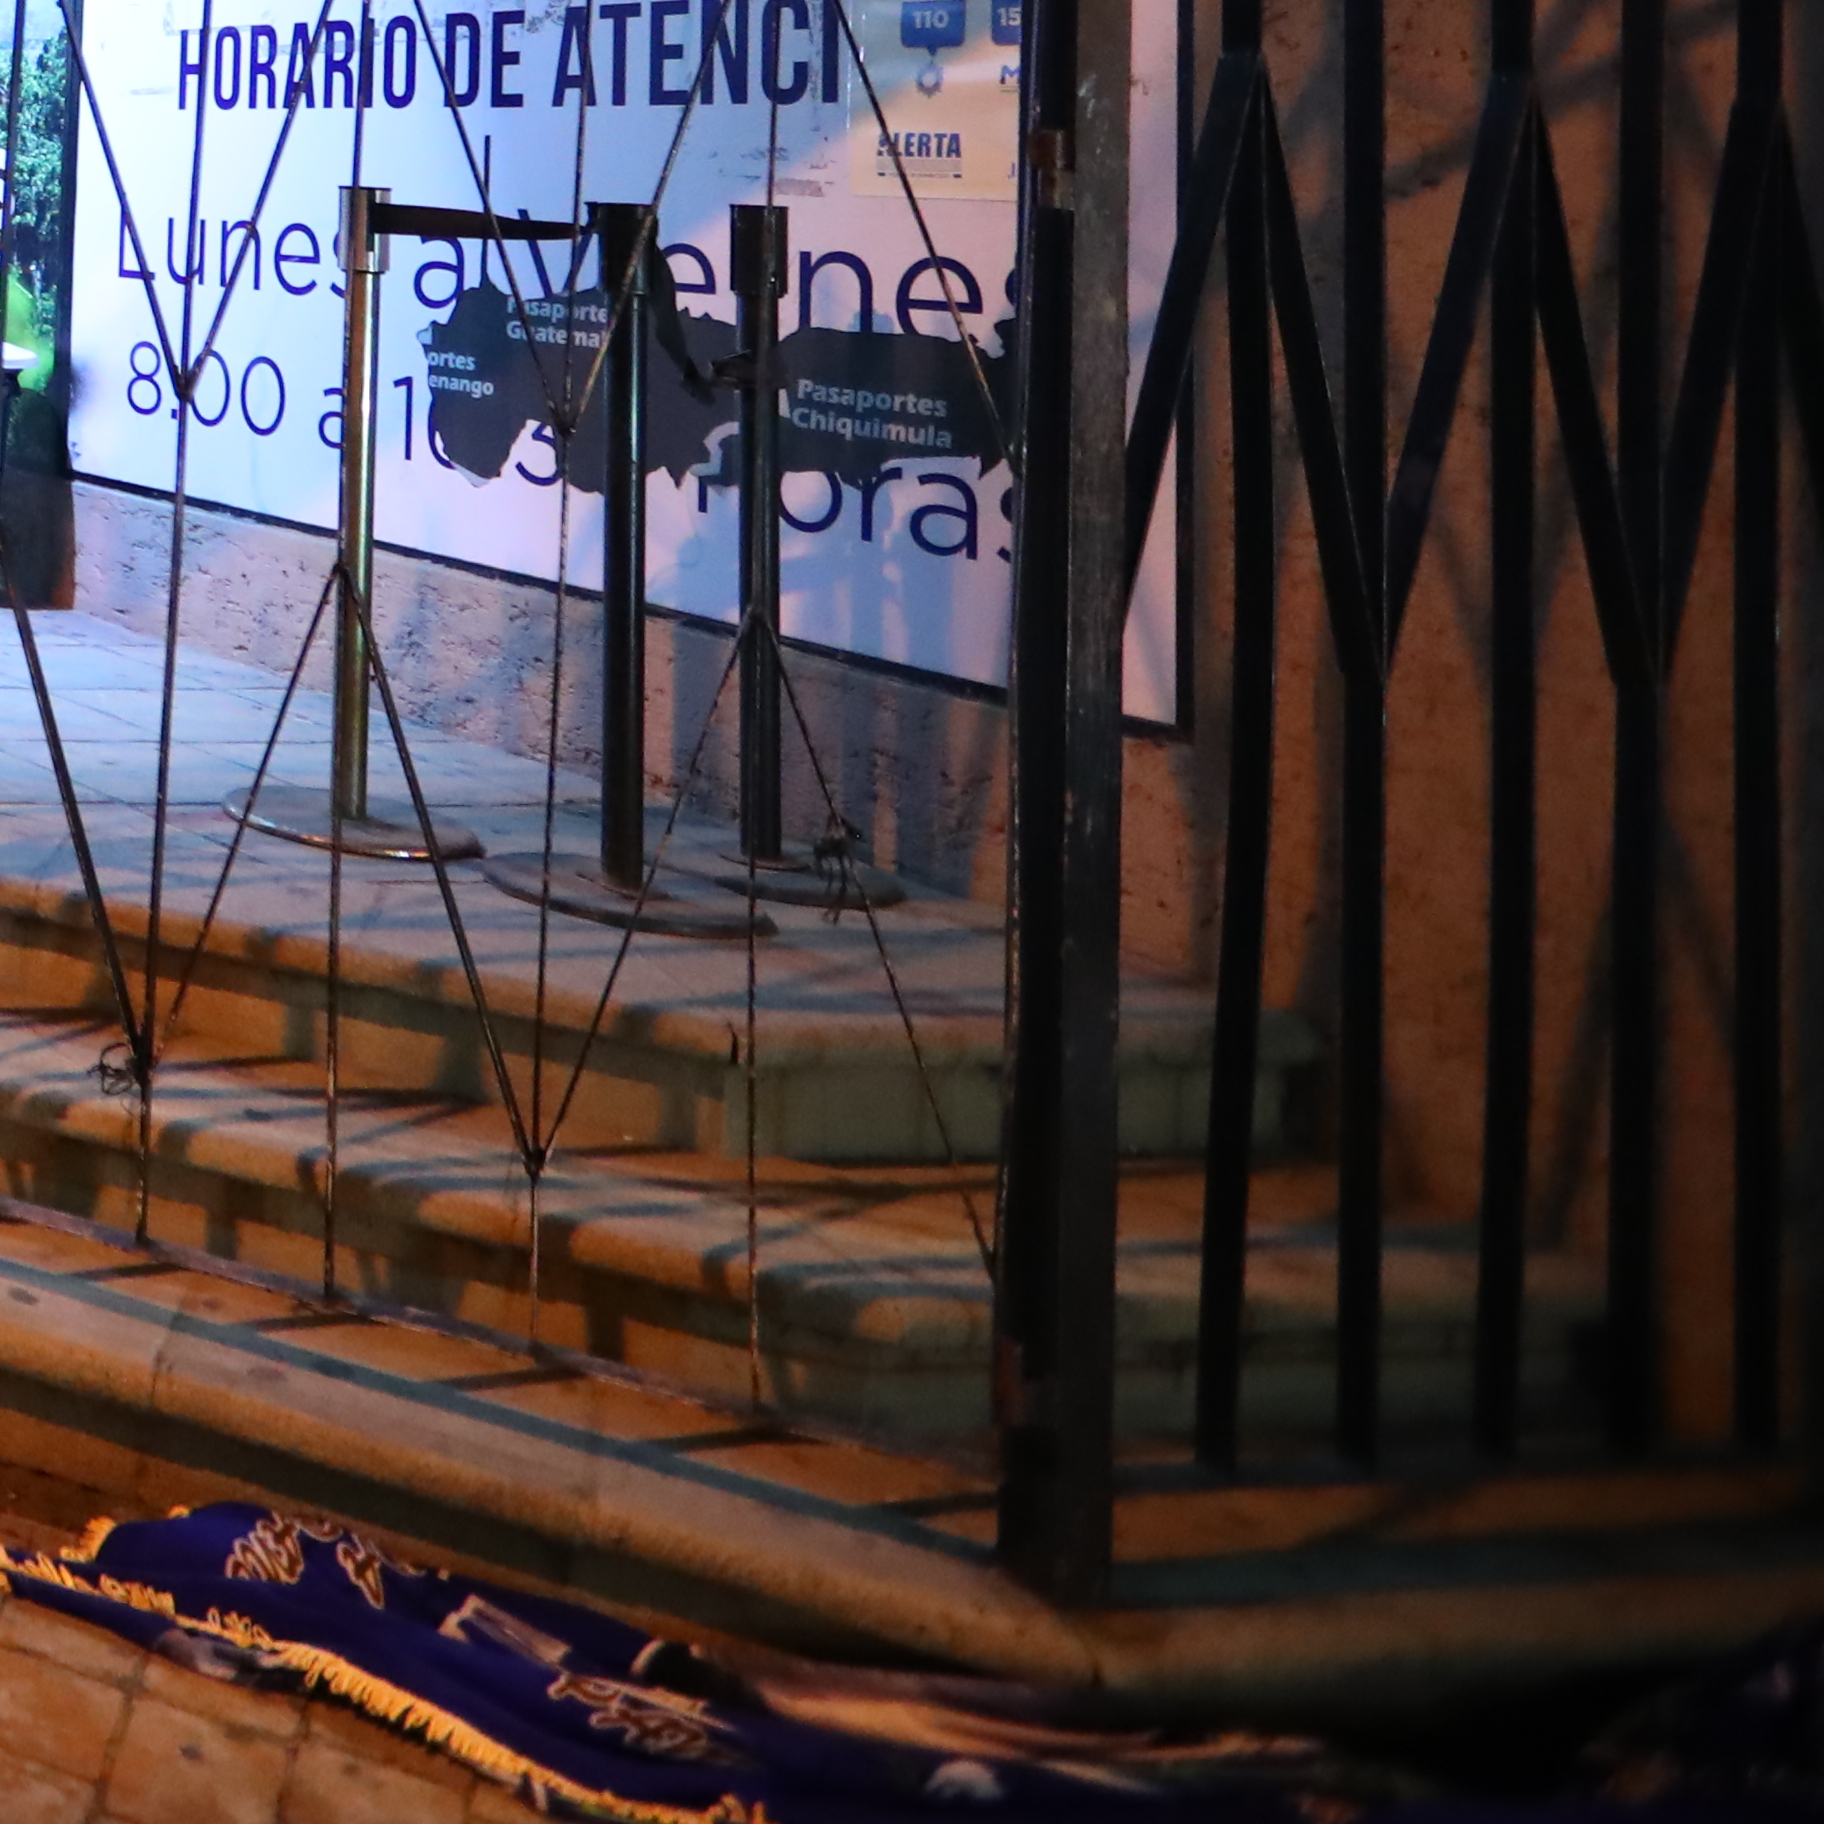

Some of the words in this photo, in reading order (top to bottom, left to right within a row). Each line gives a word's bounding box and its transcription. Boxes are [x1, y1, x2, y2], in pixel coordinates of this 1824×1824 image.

[913, 10, 949, 29] 110
[177, 14, 418, 112] HORARIO
[445, 10, 525, 109] DE
[796, 378, 948, 418] Pasaportes
[791, 407, 952, 449] Chiquimula
